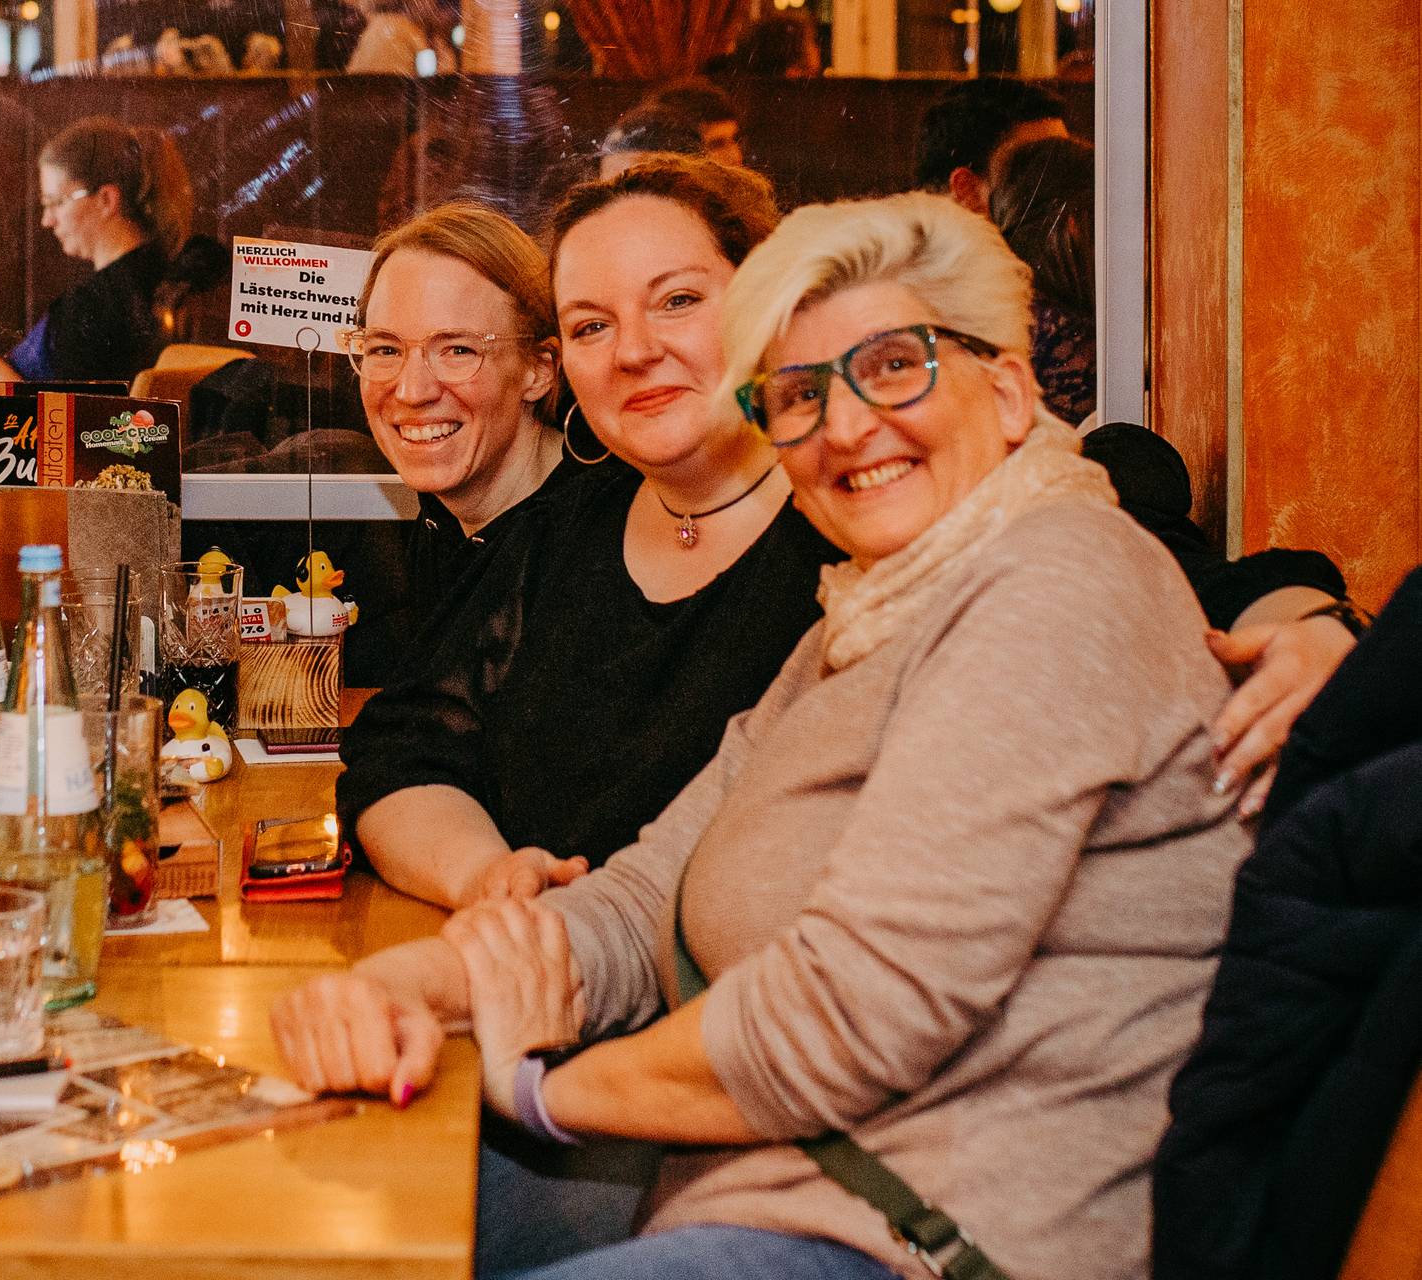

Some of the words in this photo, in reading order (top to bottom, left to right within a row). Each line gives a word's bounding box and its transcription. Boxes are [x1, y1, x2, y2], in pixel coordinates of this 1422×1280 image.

[237, 246, 296, 257] HERZLICH
[243, 256, 328, 268] WILLKOMMEN
[299, 271, 326, 285] Die
[240, 301, 268, 315] mit
[271, 304, 309, 320] Herz
[311, 311, 342, 324] und
[80, 428, 126, 443] COOL
